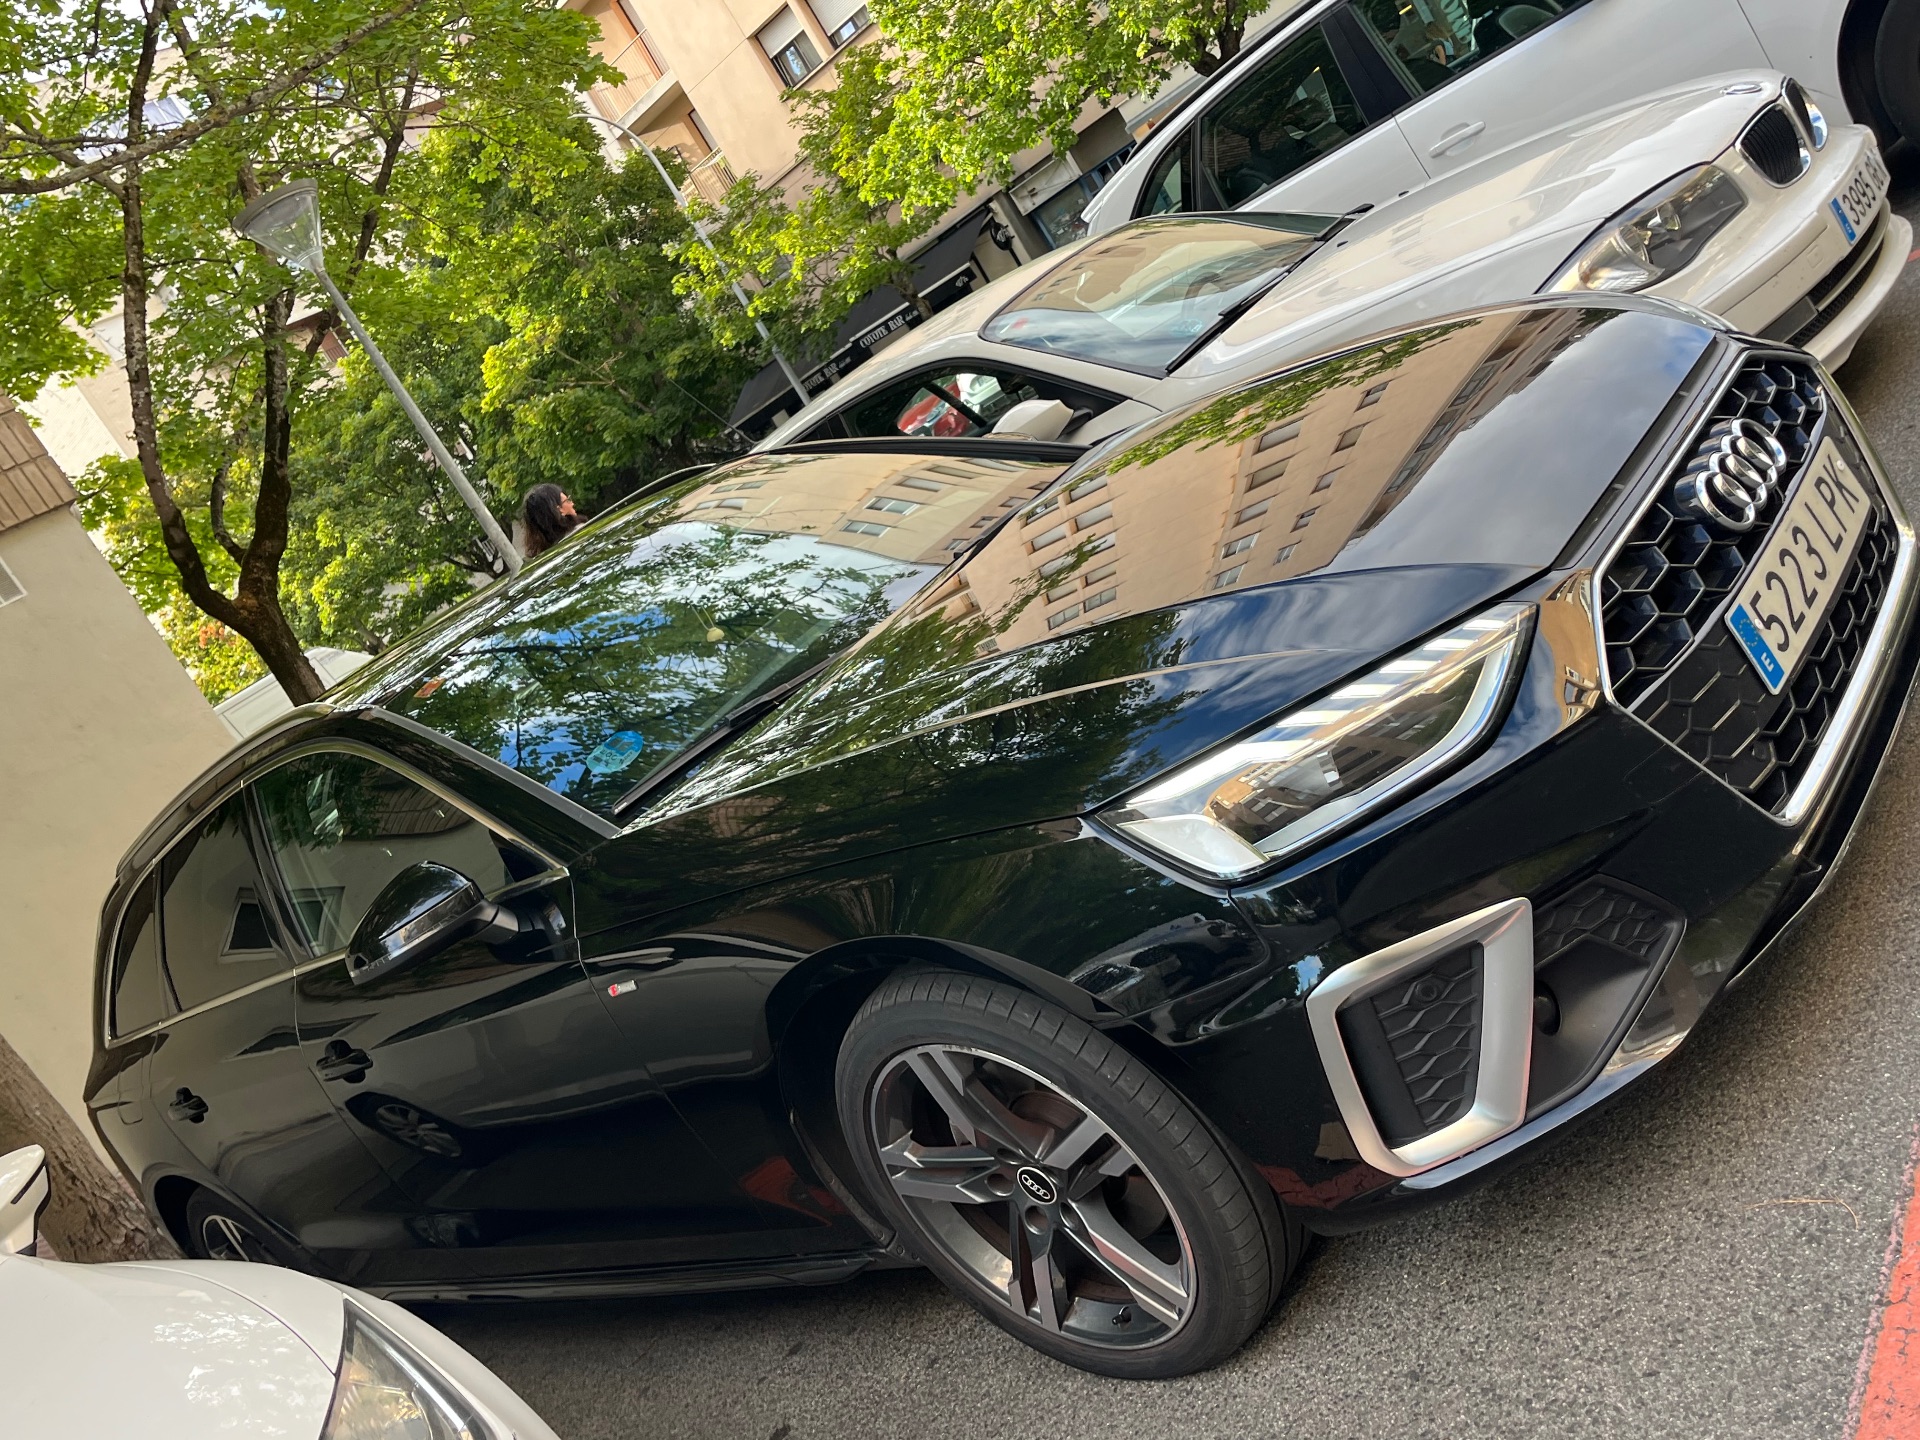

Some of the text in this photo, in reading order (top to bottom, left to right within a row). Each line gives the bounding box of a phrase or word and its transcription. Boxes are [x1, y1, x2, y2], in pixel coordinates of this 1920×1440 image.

[1842, 171, 1877, 226] 3995
[860, 325, 888, 348] COYOTE
[888, 315, 906, 331] BAR
[1749, 454, 1860, 652] 5223 LPK
[1761, 654, 1775, 672] E
